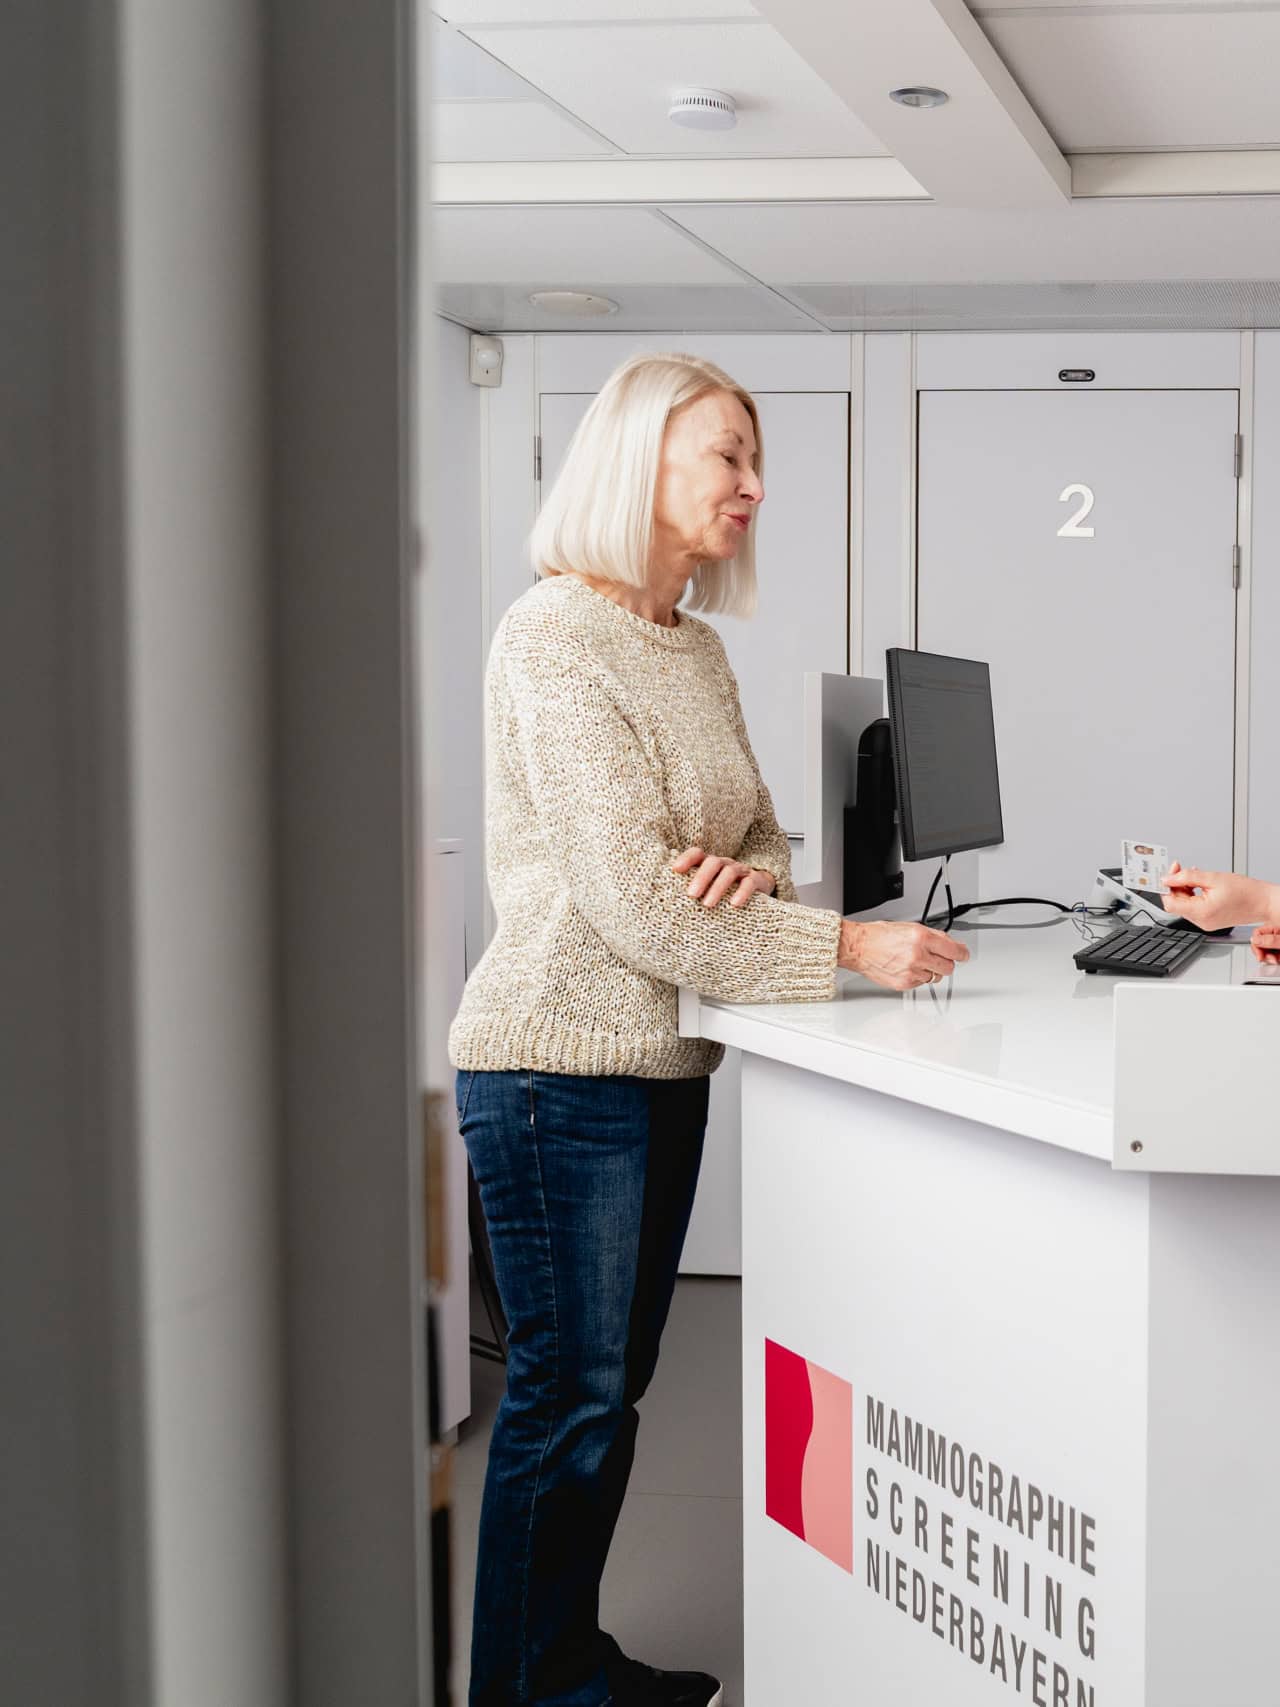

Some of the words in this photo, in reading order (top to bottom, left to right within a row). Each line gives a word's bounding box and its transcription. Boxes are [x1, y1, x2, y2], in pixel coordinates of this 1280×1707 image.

[1056, 483, 1096, 537] 2
[866, 1394, 1096, 1577] MAMMOGRAPHIE
[866, 1466, 1095, 1661] SCREENING
